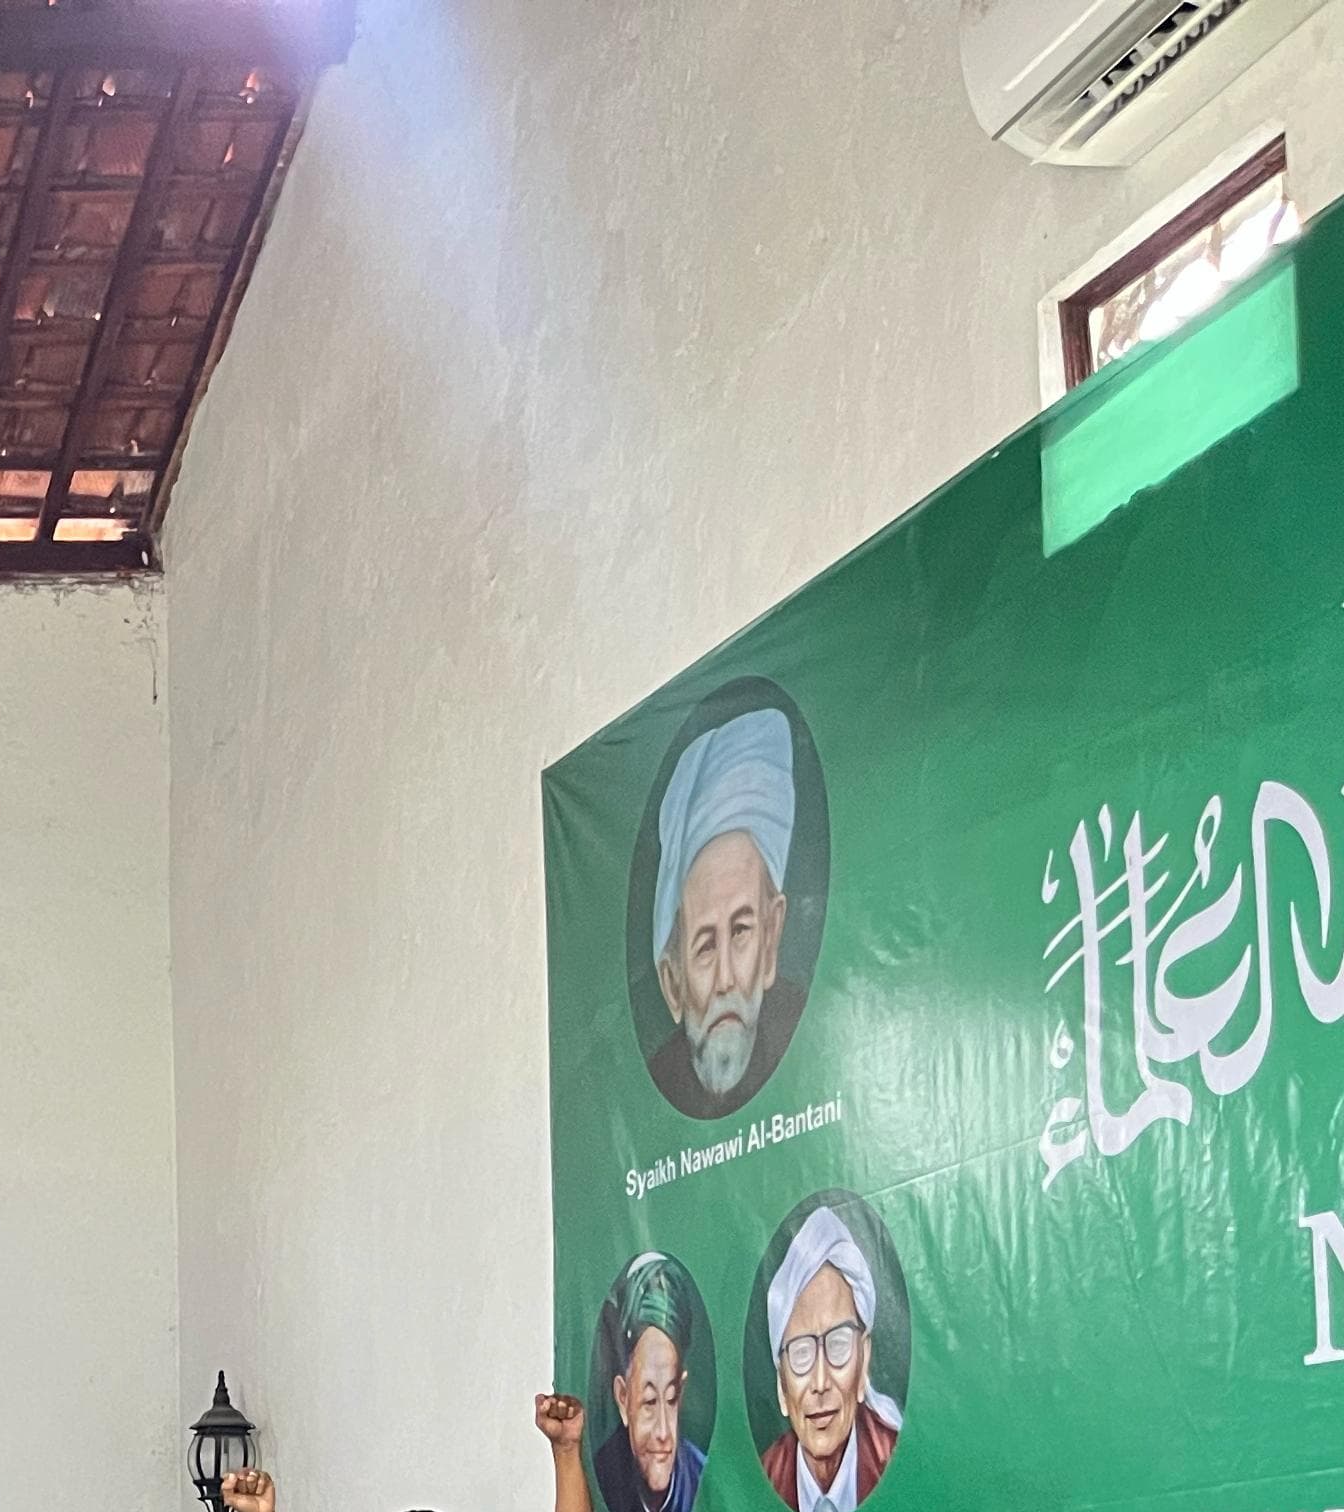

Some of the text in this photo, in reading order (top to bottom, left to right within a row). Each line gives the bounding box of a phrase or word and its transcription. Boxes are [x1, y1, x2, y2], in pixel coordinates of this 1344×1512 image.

[625, 1090, 842, 1200] Syaikh Nawawi Al-Bantani
